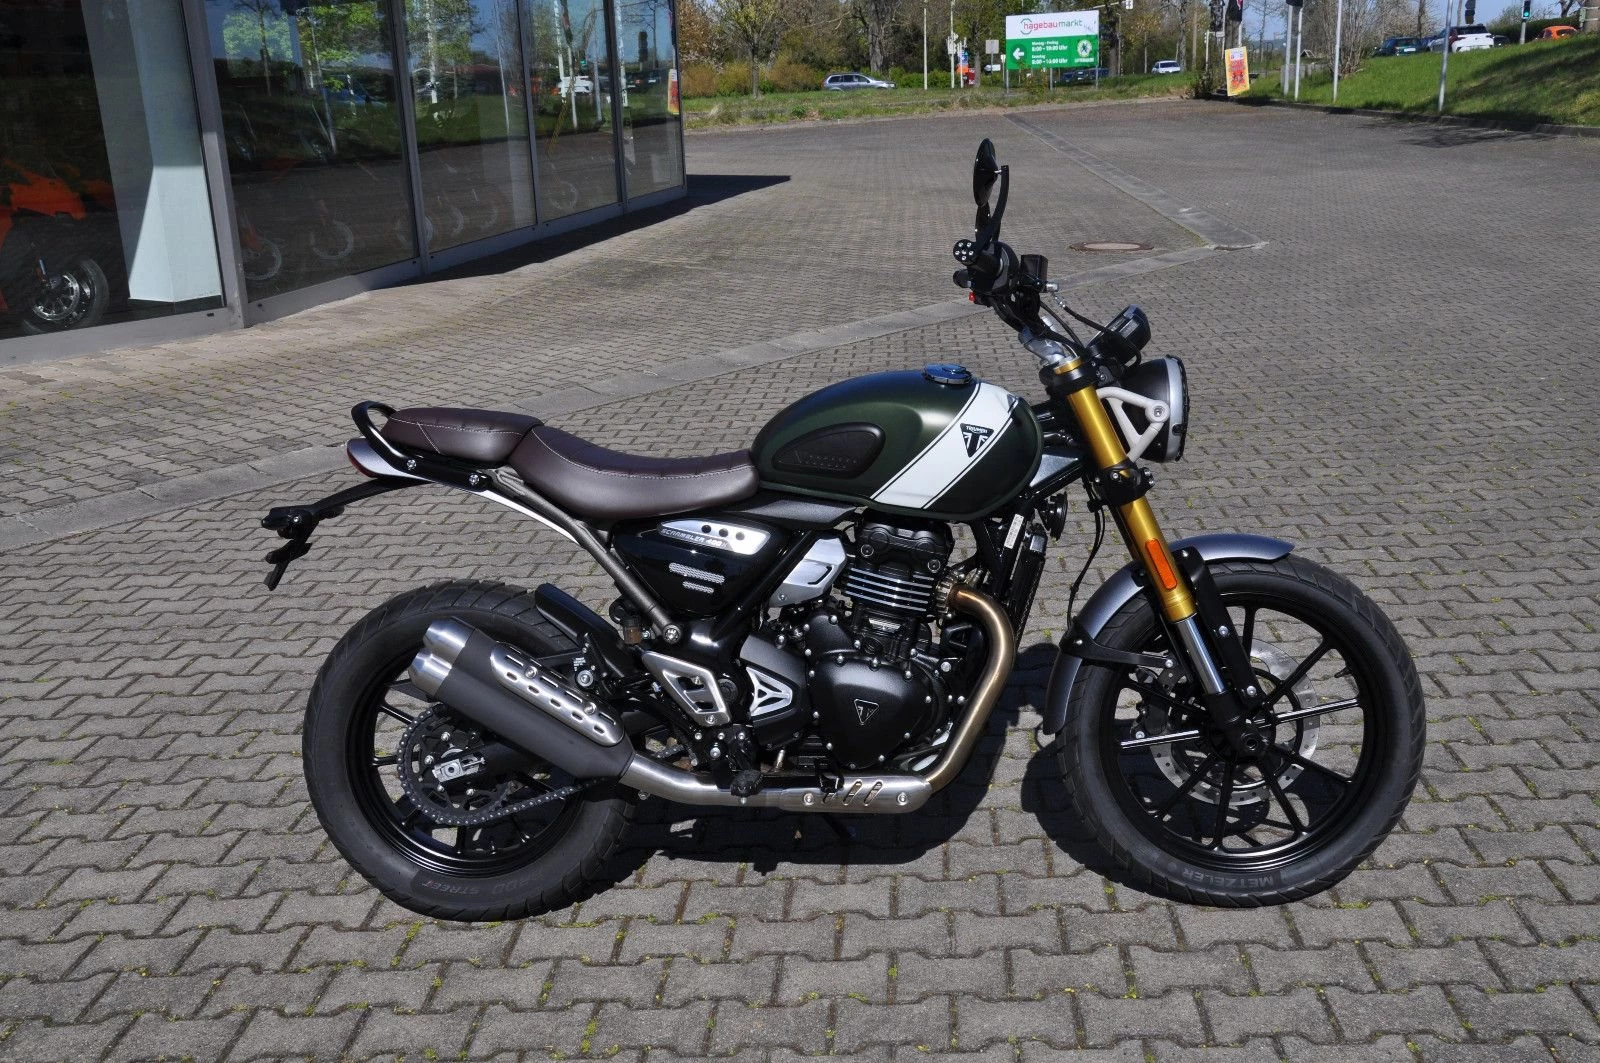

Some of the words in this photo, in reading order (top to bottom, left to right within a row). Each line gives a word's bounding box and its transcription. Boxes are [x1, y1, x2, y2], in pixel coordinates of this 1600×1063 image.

[1023, 19, 1083, 30] hagebaumarkt
[966, 425, 988, 434] TRIUMPH
[661, 529, 705, 542] SCRAMBLER
[1182, 868, 1275, 888] METZELER
[421, 880, 480, 894] STREET
